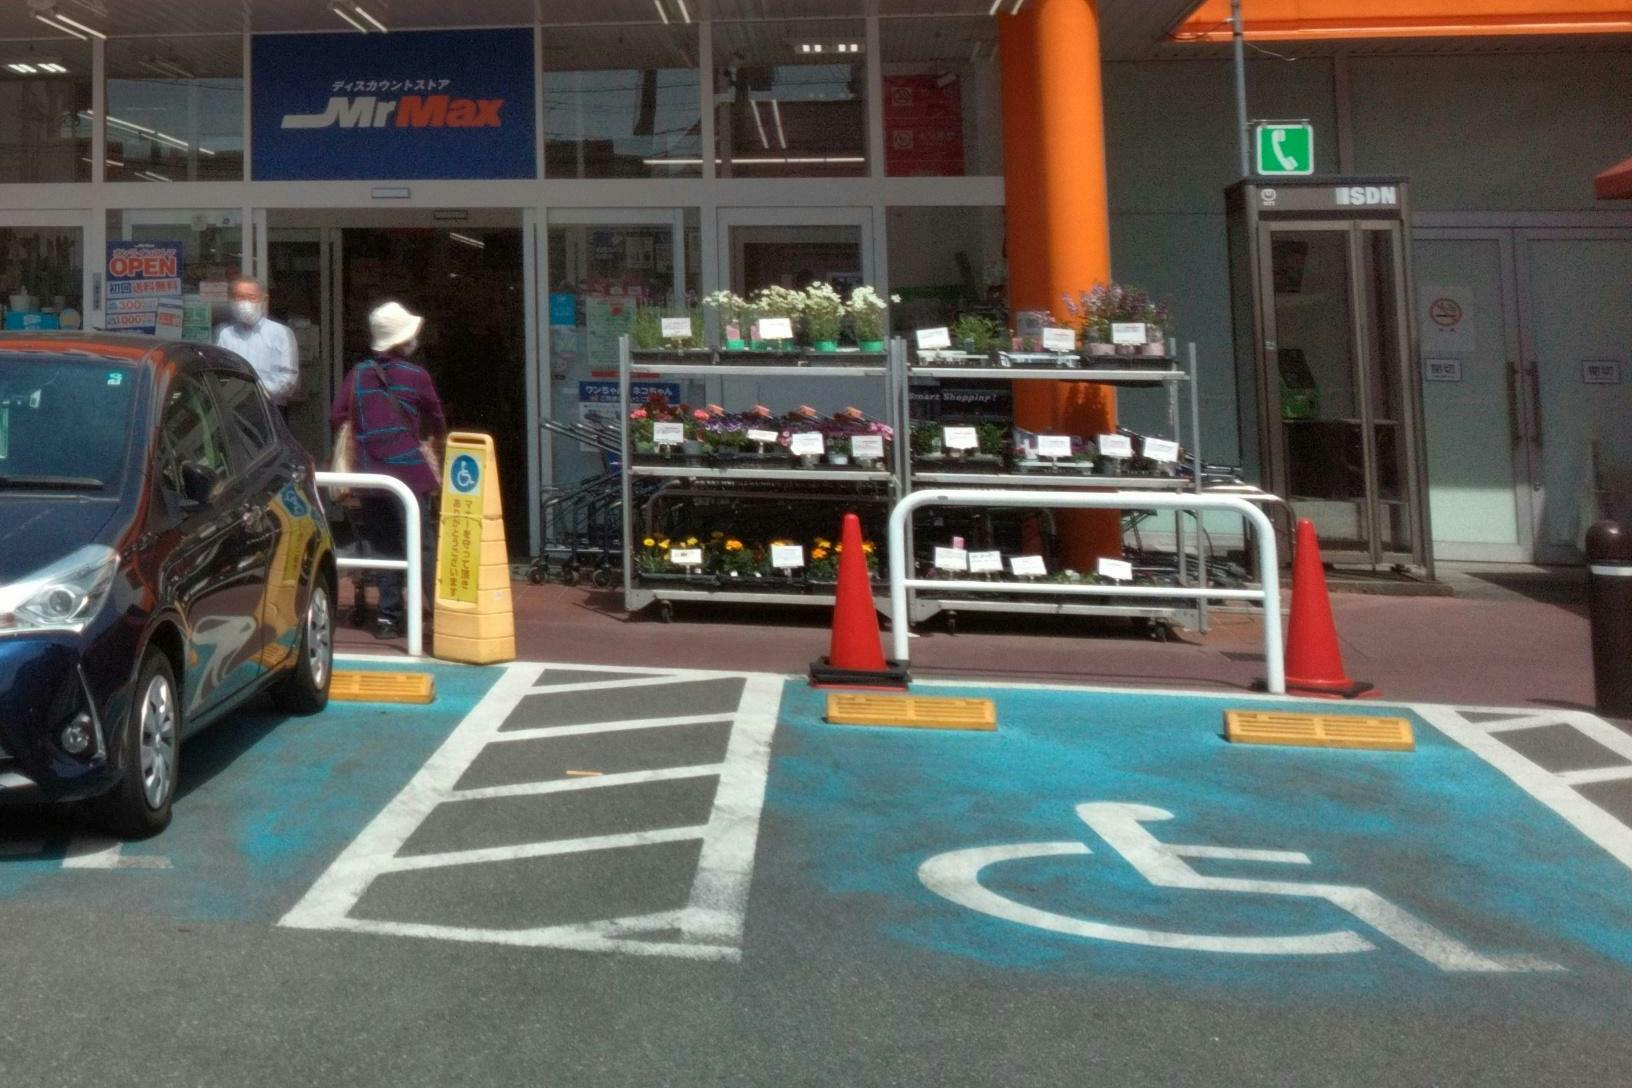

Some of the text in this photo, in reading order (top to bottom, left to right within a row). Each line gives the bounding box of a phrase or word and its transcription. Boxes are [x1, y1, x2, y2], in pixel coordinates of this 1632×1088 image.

[331, 78, 451, 92] ディスカウントストア
[280, 95, 505, 129] MrMax
[1335, 185, 1397, 206] ISDN
[109, 256, 176, 278] OPEN
